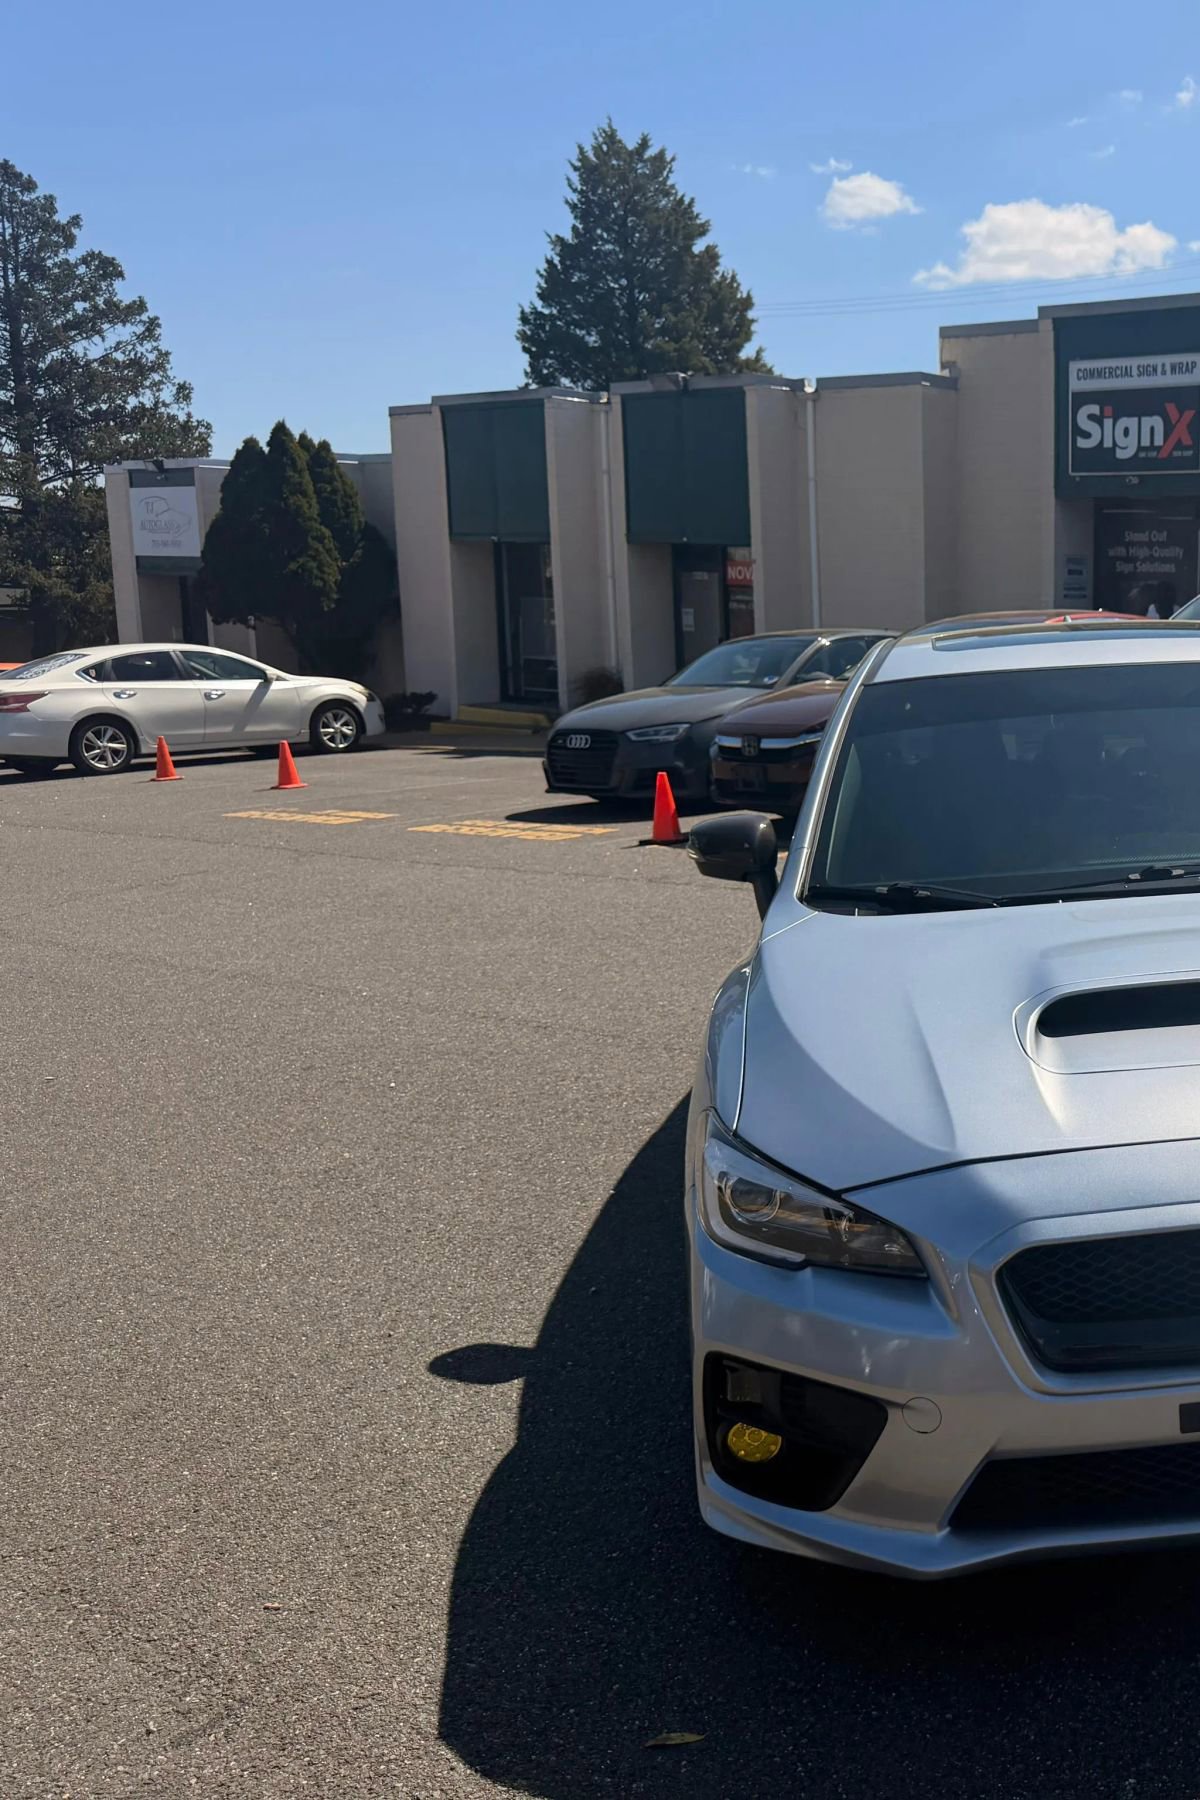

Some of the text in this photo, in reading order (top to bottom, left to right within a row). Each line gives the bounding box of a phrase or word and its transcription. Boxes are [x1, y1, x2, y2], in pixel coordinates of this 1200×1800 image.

[1076, 361, 1197, 381] COMMERCIAL SIGN & WRAP
[1076, 402, 1196, 459] SignX
[1124, 530, 1167, 542] Stand Out
[1108, 546, 1184, 560] with High-Quality
[1115, 561, 1176, 574] Sign Solutions
